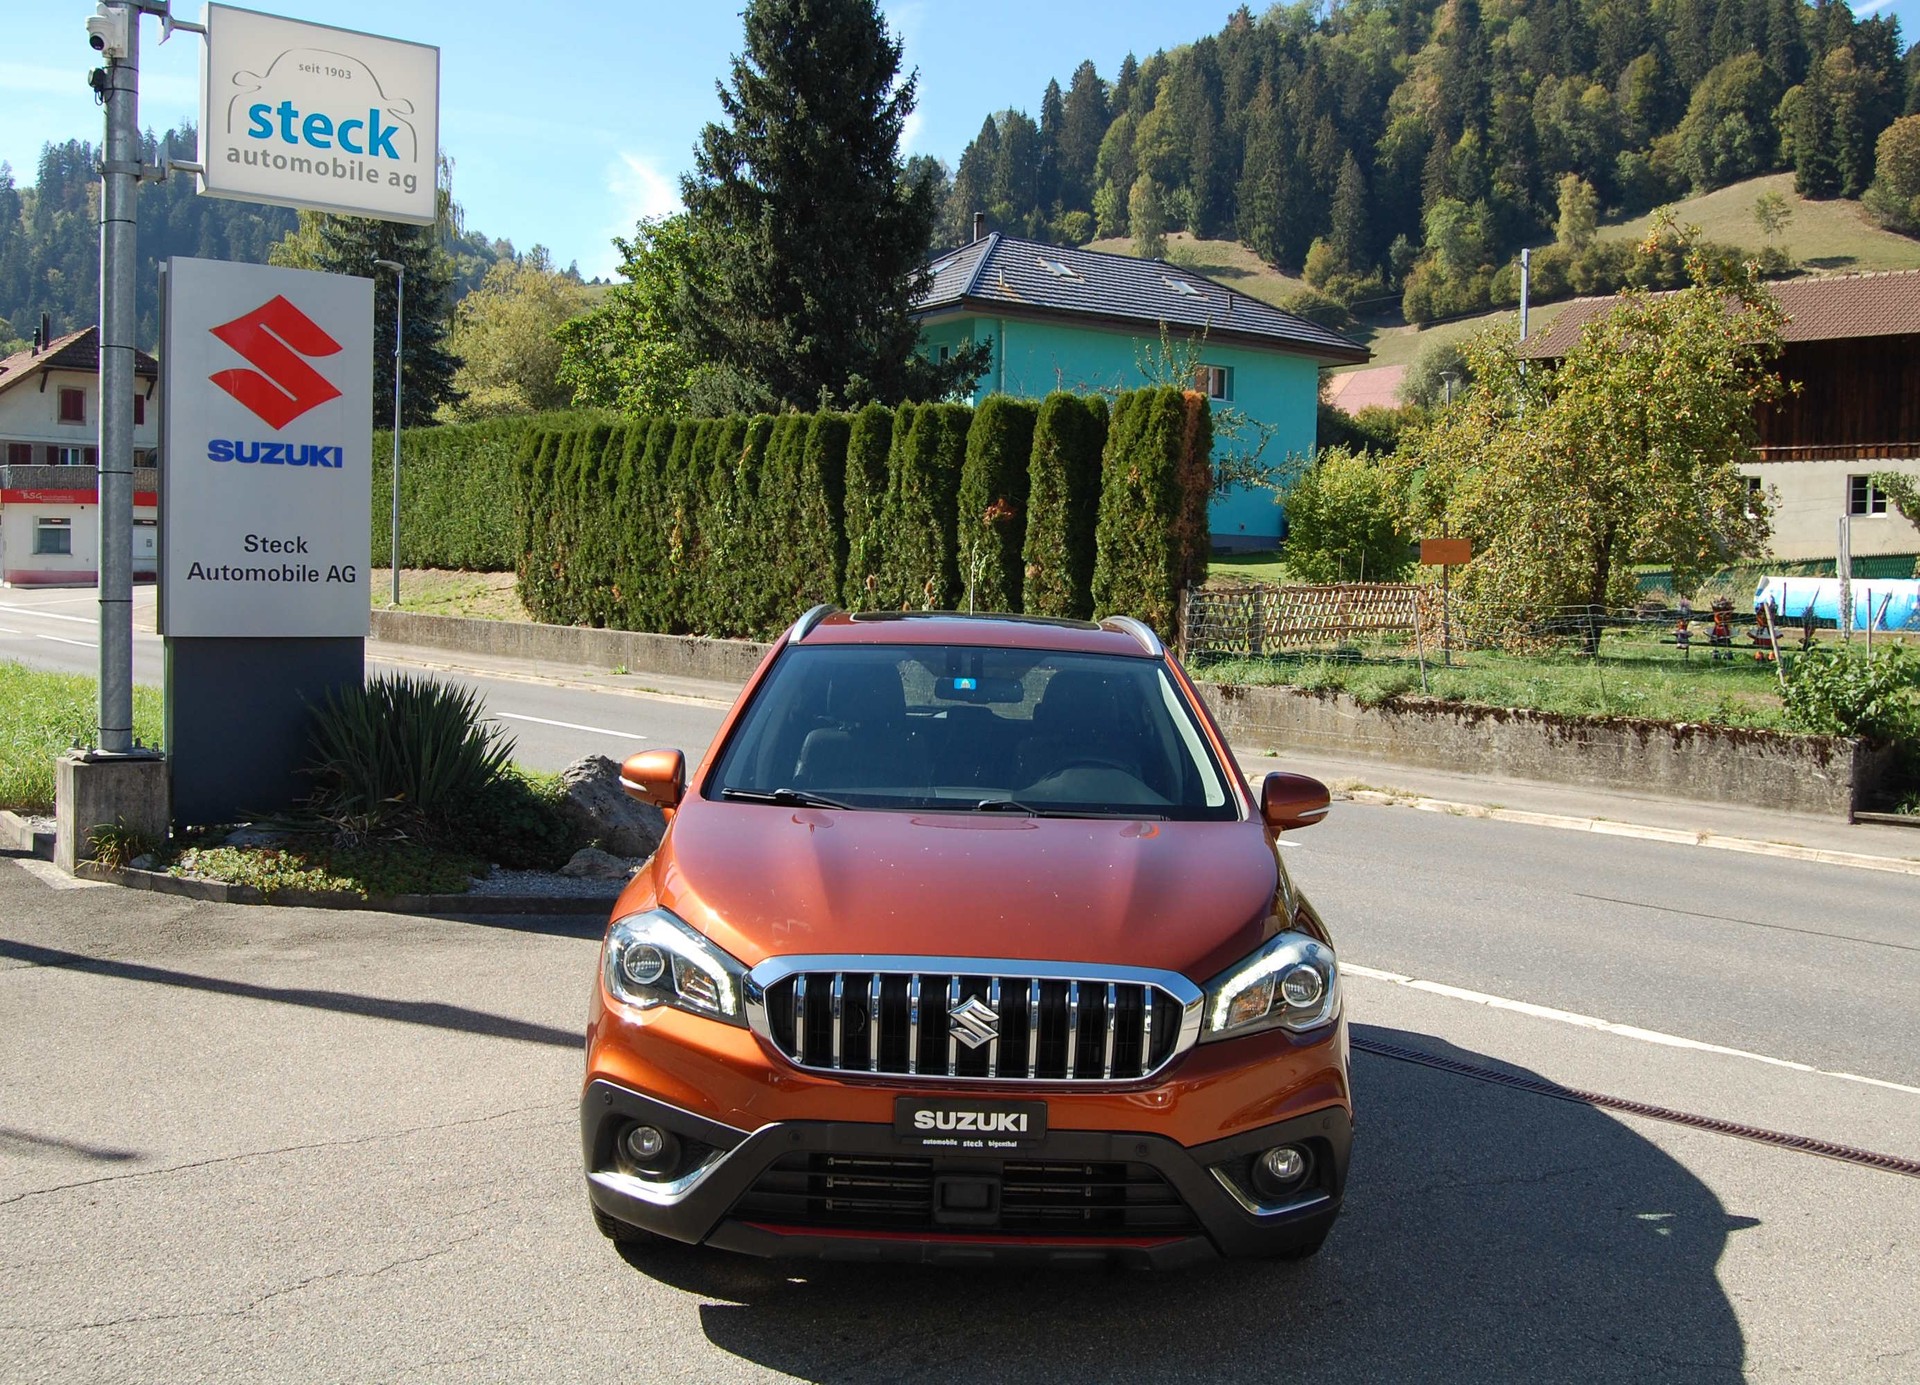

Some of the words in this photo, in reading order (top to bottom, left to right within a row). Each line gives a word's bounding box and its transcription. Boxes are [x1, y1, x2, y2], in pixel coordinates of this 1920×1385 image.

[298, 63, 320, 75] seit
[325, 66, 352, 80] 1903
[248, 100, 400, 160] steck
[226, 147, 379, 184] automobile
[387, 171, 417, 194] ag
[207, 439, 343, 469] SUZUKI
[243, 533, 309, 554] Steck
[186, 561, 320, 583] Automobile
[325, 564, 356, 583] AG
[913, 1110, 1028, 1132] SUZUKI
[922, 1138, 958, 1146] automobile
[962, 1139, 984, 1148] steck
